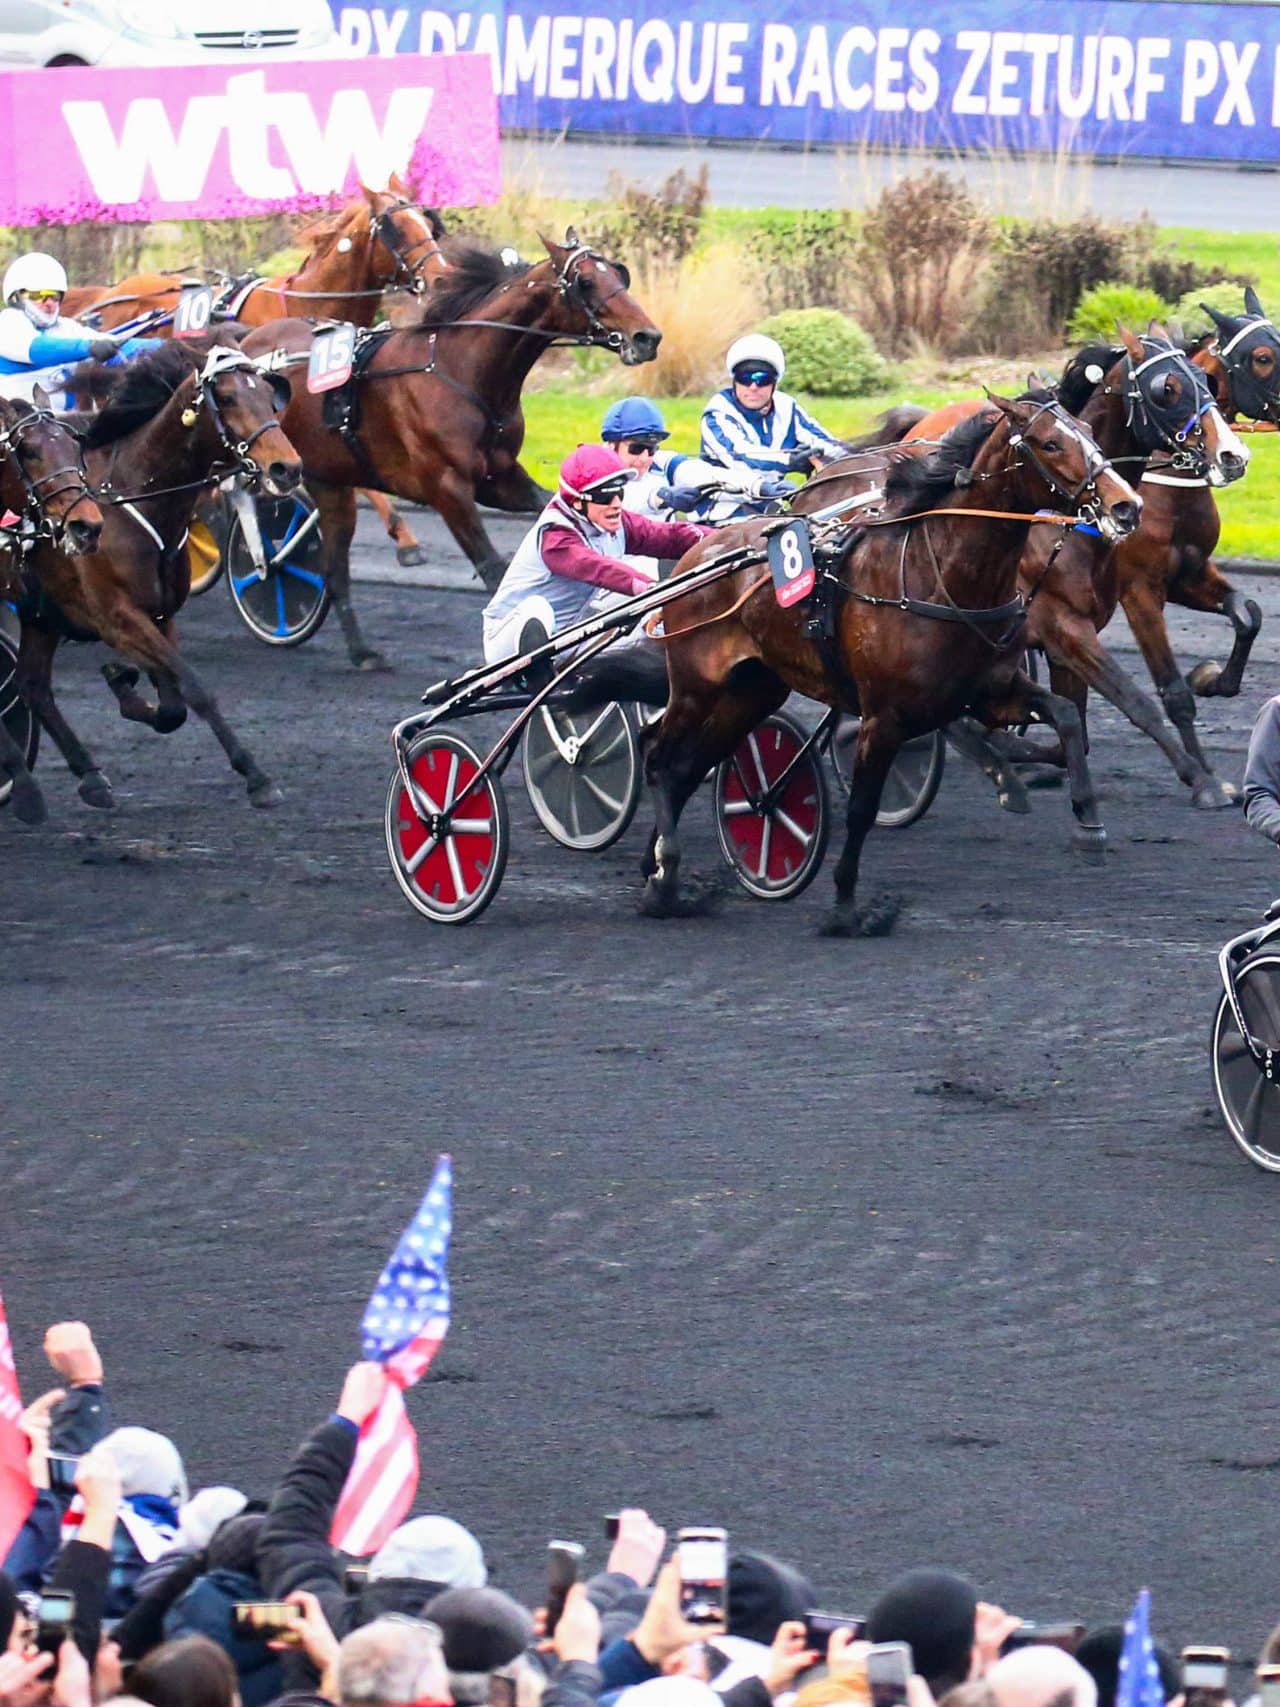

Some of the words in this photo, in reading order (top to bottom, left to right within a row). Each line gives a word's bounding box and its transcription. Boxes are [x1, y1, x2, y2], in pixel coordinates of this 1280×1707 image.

[420, 9, 749, 105] D'AMERIQUE
[759, 23, 942, 113] RACES
[951, 30, 1171, 122] ZETURF
[1180, 39, 1260, 127] PX
[61, 70, 435, 205] wtw
[178, 291, 210, 331] 10
[315, 333, 350, 375] 15
[780, 529, 803, 579] 8
